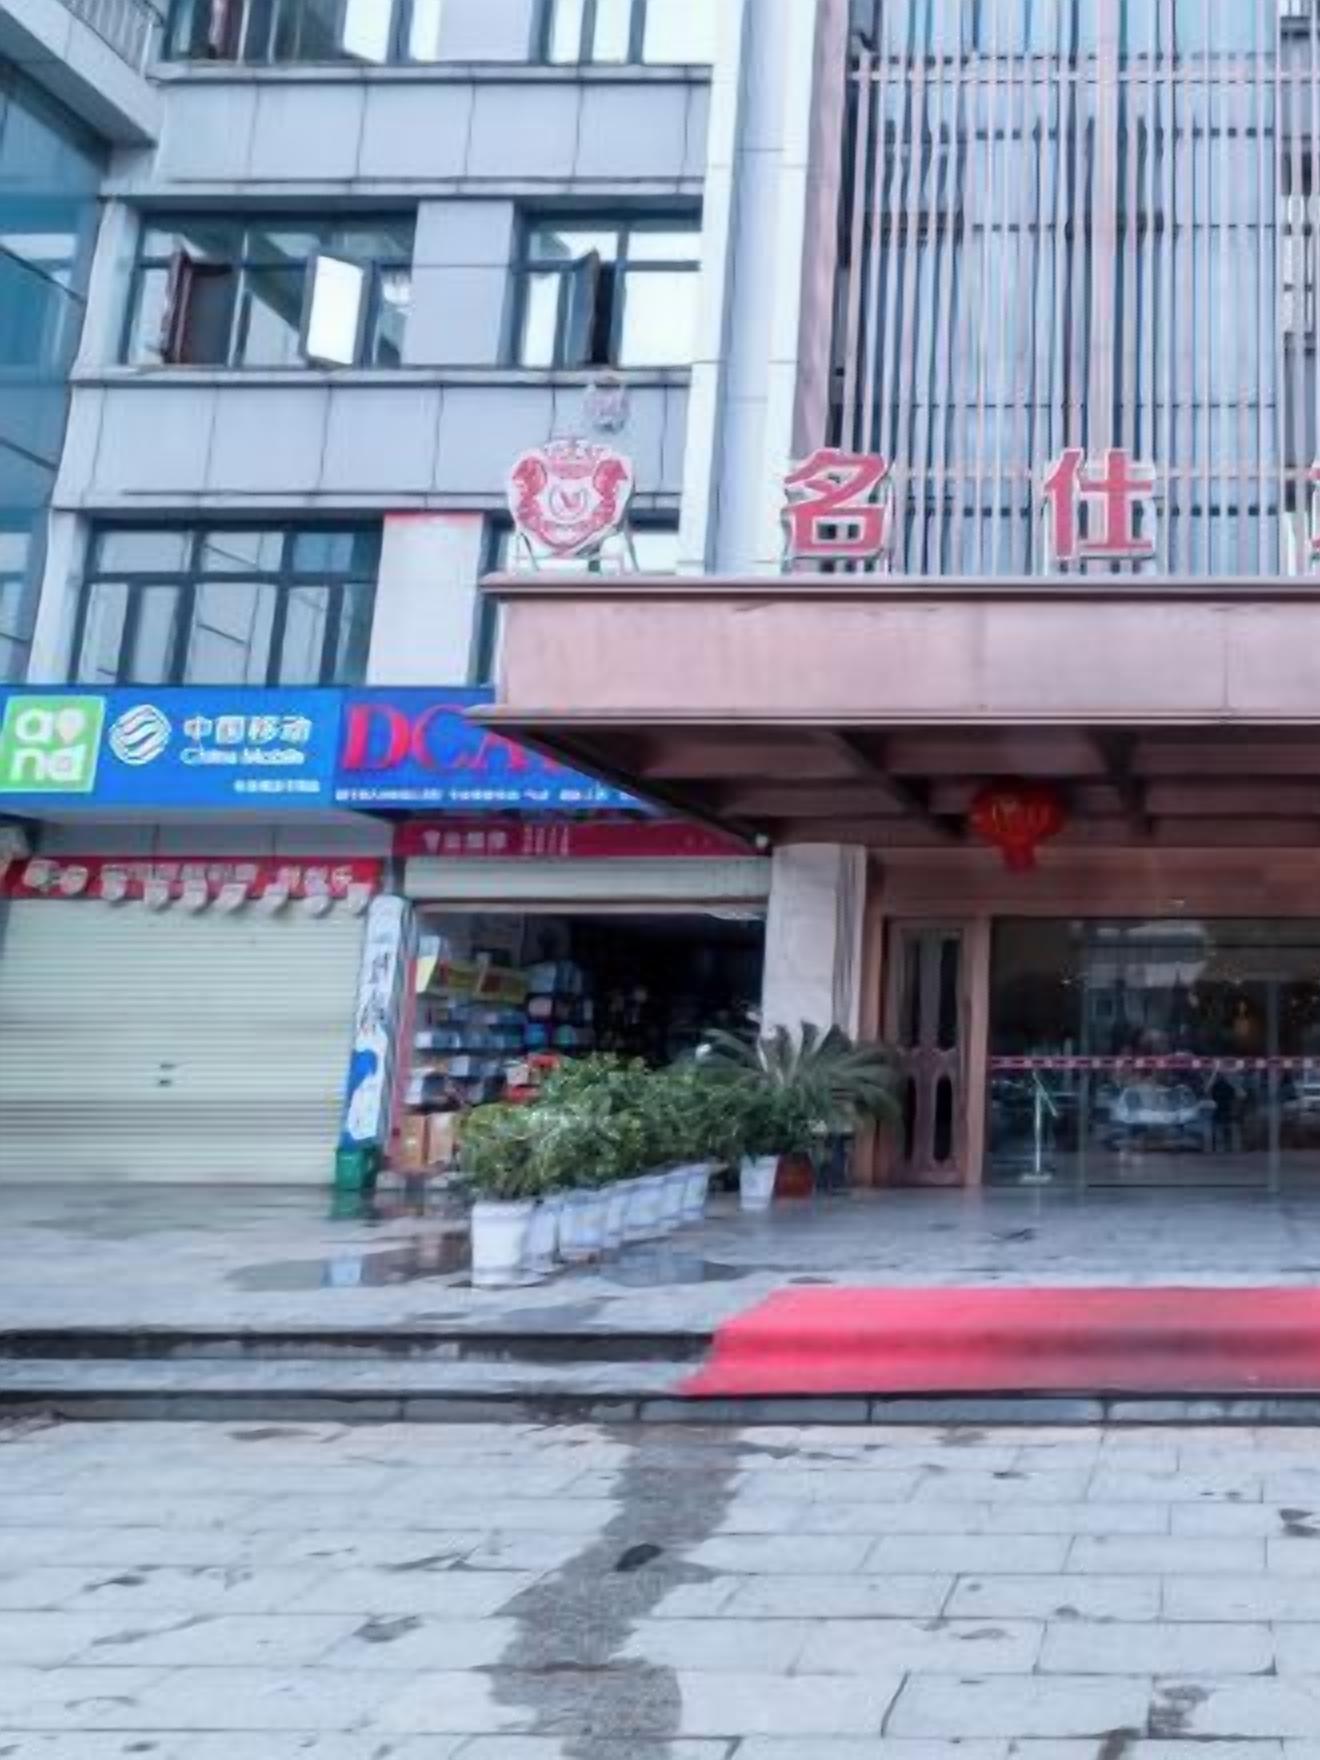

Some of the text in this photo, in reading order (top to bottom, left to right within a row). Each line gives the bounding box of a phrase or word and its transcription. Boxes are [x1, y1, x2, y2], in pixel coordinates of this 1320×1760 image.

[183, 714, 313, 746] 中国移动
[342, 703, 564, 773] DCA
